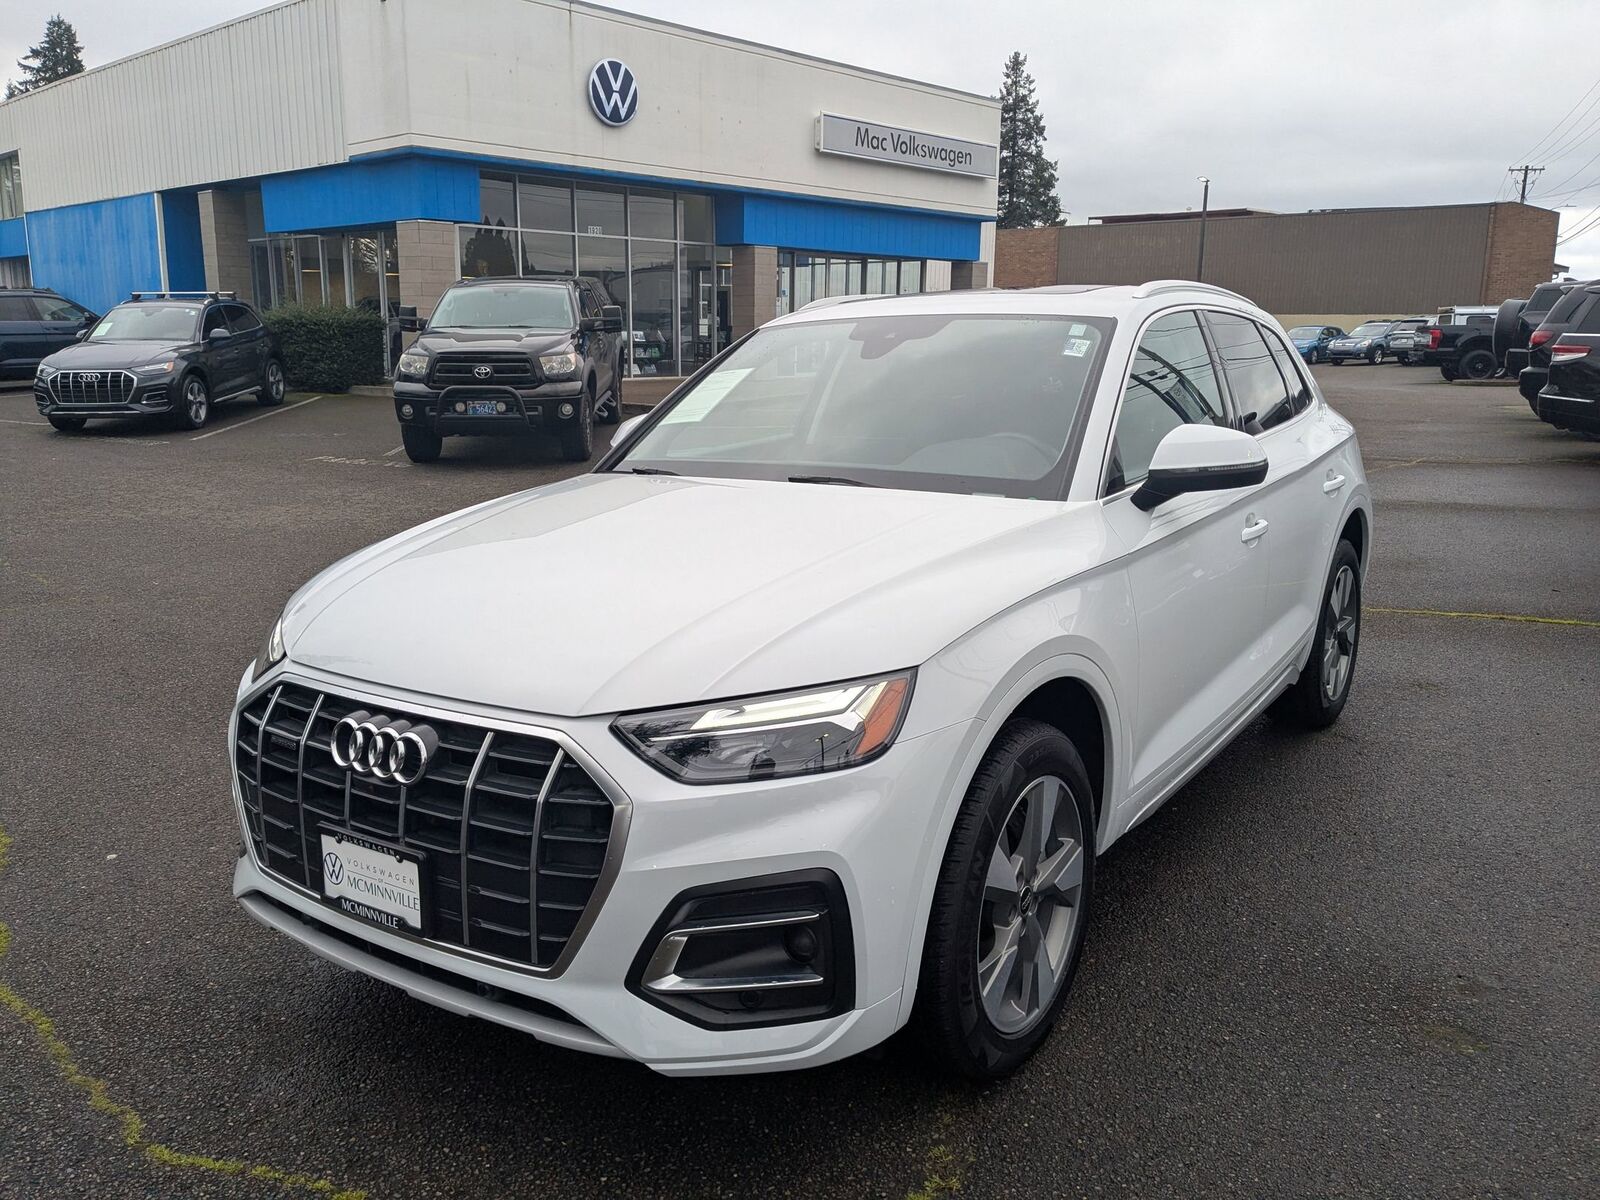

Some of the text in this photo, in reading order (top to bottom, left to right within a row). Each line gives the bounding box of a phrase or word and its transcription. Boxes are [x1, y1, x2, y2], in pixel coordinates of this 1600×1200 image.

[855, 126, 972, 167] Mac Volkswagen
[337, 833, 395, 856] VOLKSWAGEN
[347, 858, 415, 886] VOLKSWAGEN
[347, 875, 420, 911] MCMINNVILLE
[341, 899, 399, 929] MCMINNVILLE
